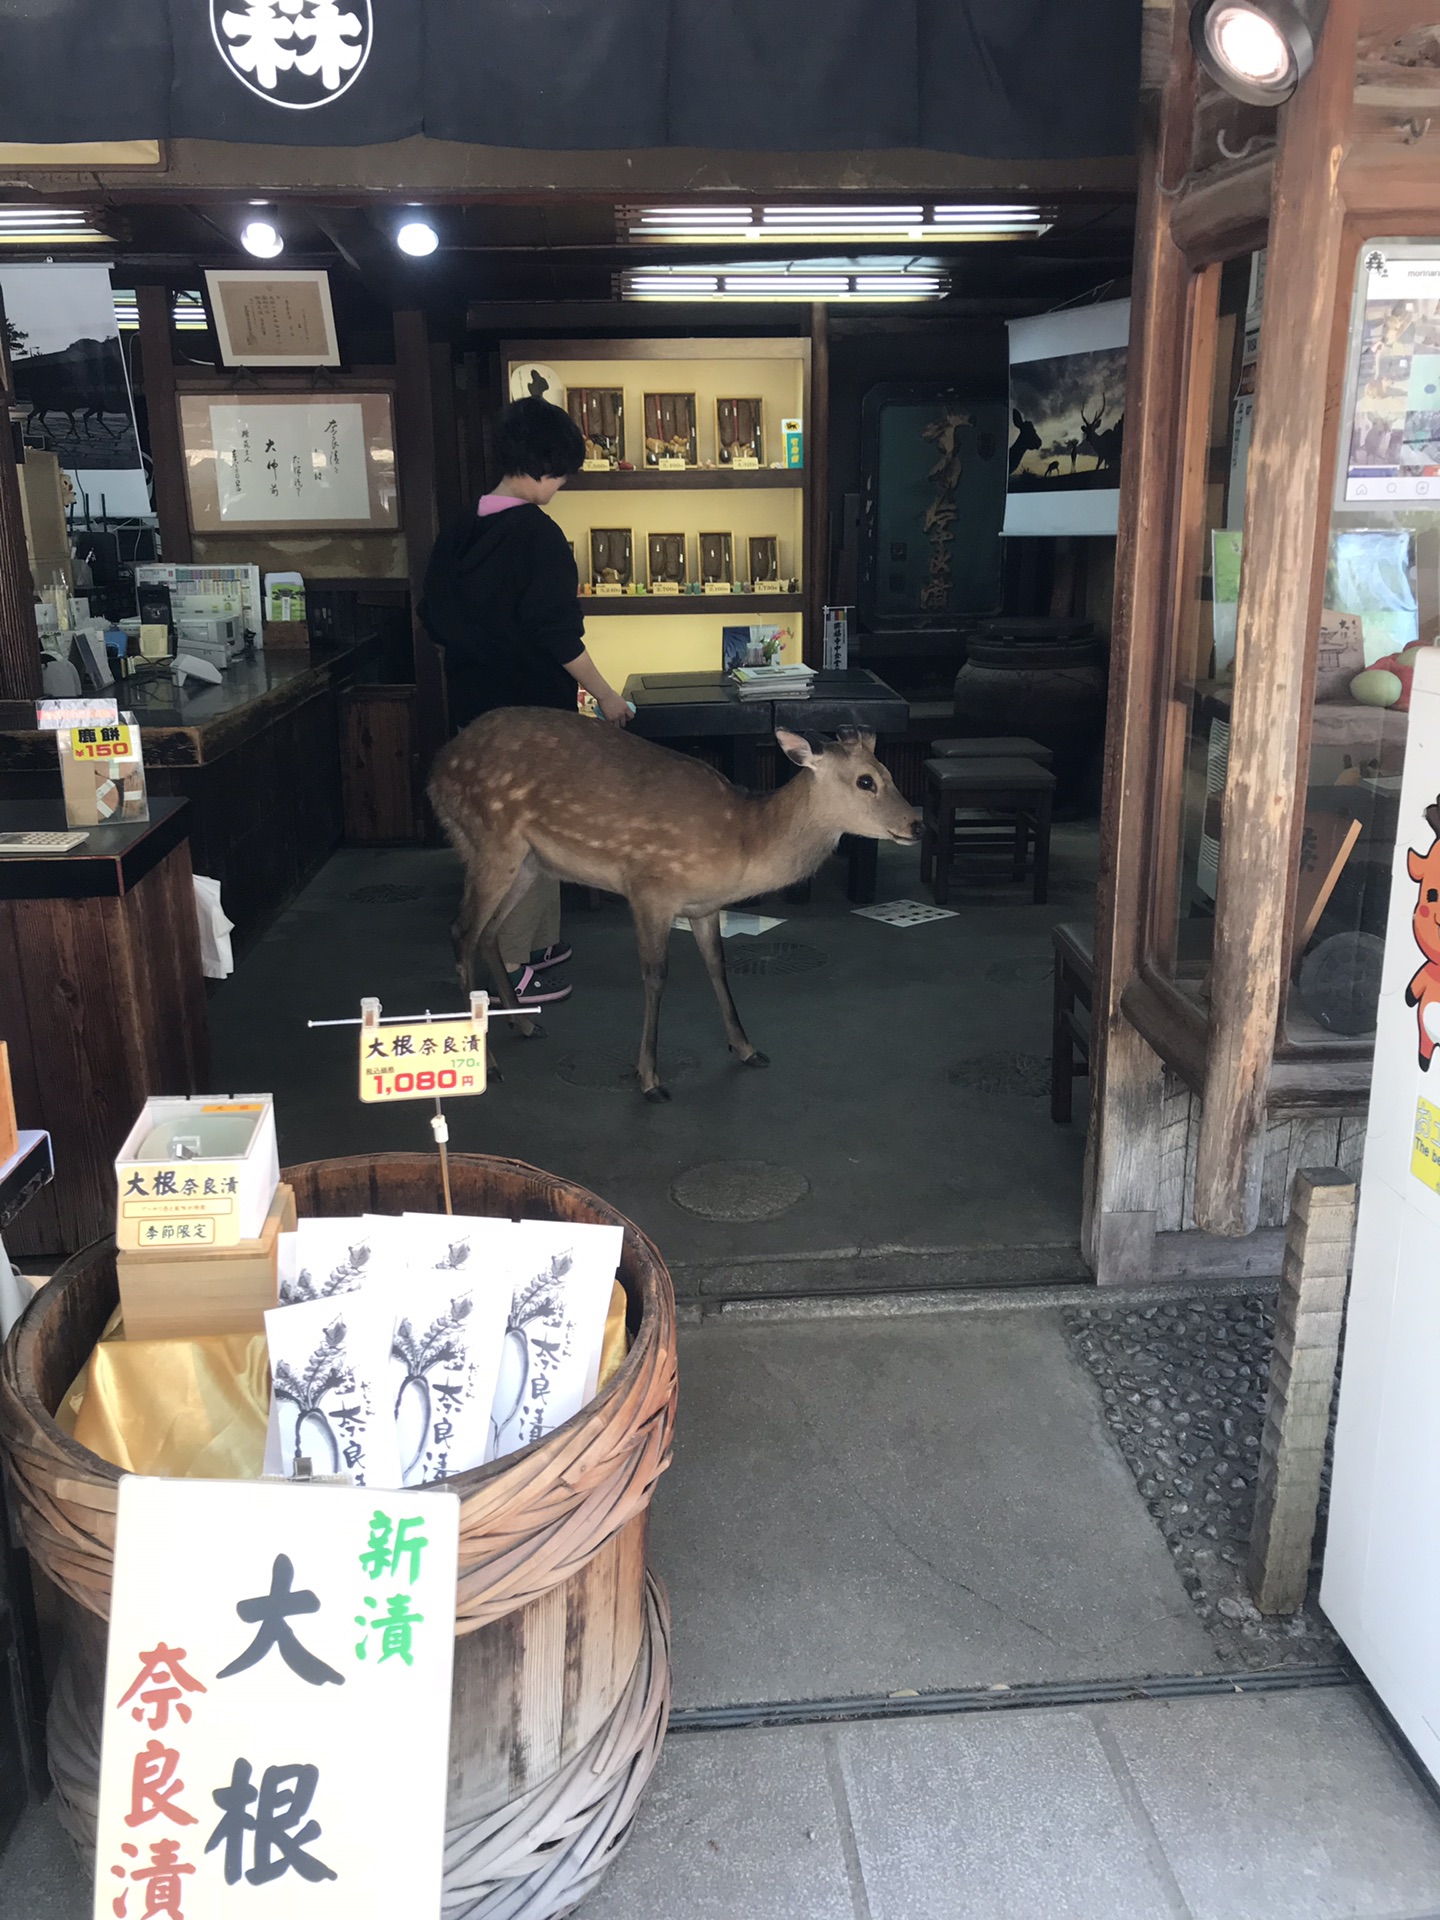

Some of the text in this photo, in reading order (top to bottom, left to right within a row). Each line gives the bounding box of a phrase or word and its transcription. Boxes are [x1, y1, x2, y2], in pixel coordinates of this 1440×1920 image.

[75, 743, 129, 757] ¥150
[365, 1034, 481, 1058] 大根奈良漬
[373, 1069, 474, 1095] 1,080円
[1415, 1137, 1430, 1157] The
[123, 1170, 239, 1197] 大根奈良漬
[146, 1223, 208, 1240] 季節限定
[353, 1509, 429, 1667] 新漬
[203, 1553, 346, 1887] 大根
[110, 1641, 208, 1920] 奈良漬
